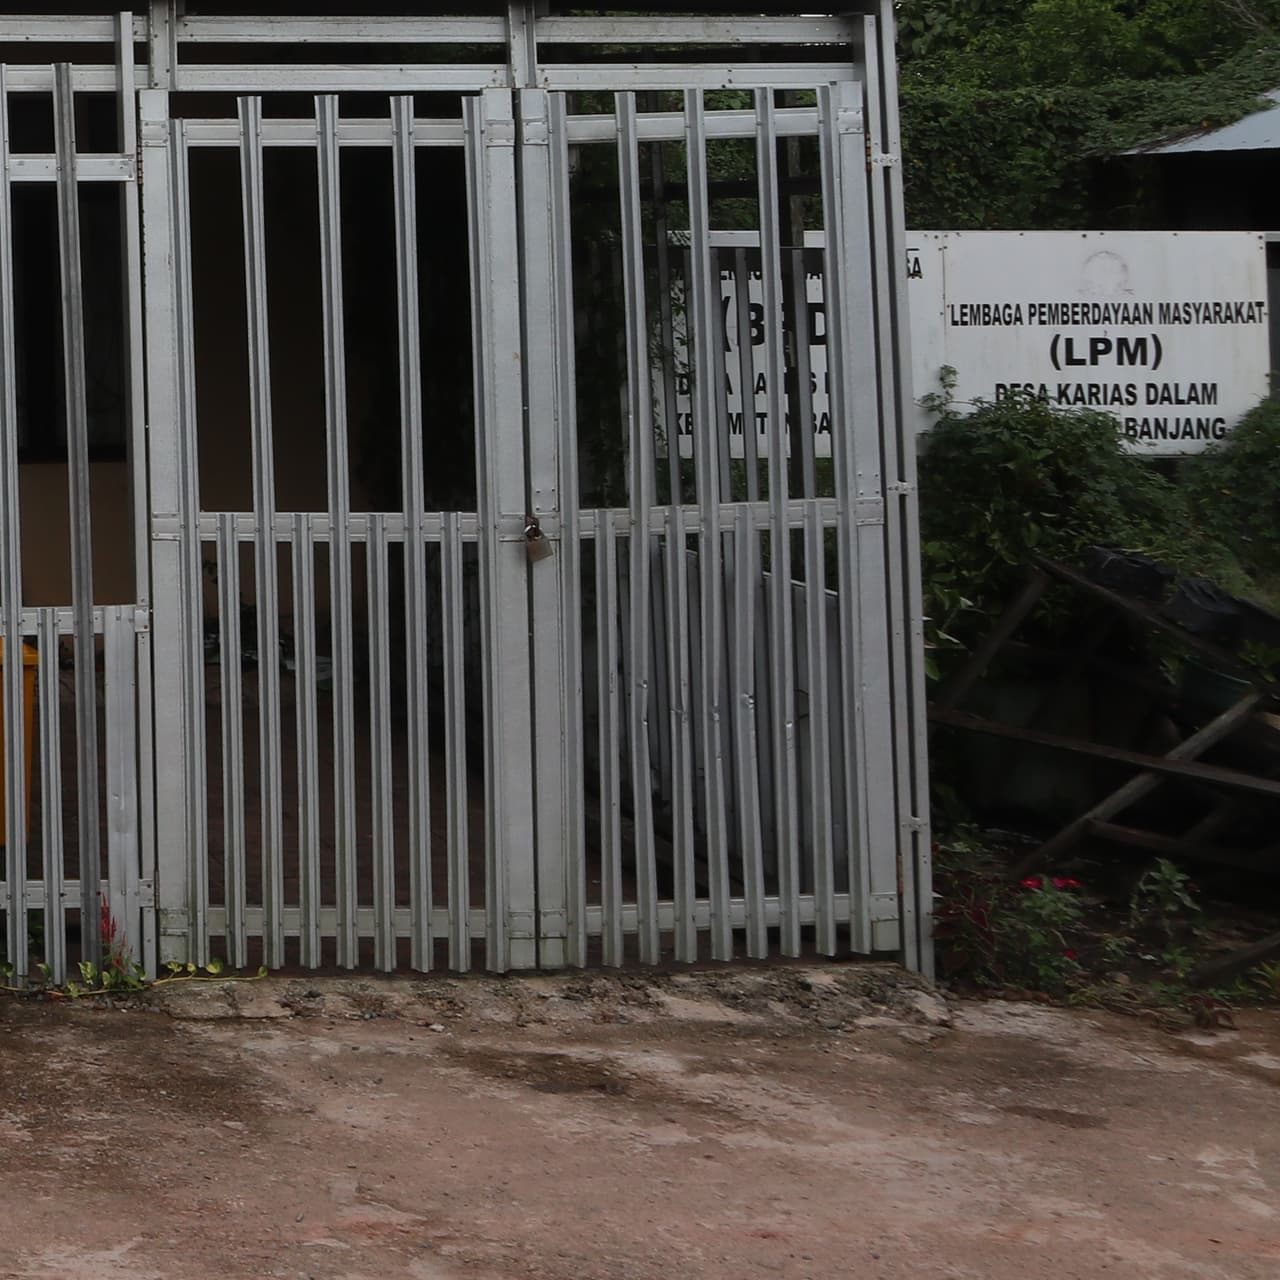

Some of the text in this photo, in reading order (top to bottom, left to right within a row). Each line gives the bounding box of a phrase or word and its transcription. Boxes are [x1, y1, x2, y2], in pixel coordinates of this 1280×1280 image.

[950, 301, 1265, 326] LEMBAGA PEMBERDAYAAN MASYARAKAT
[1050, 334, 1163, 370] (LPM)
[1056, 383, 1138, 406] KARIAS
[1146, 383, 1218, 405] DALAM
[1124, 417, 1226, 440] BANJANG
